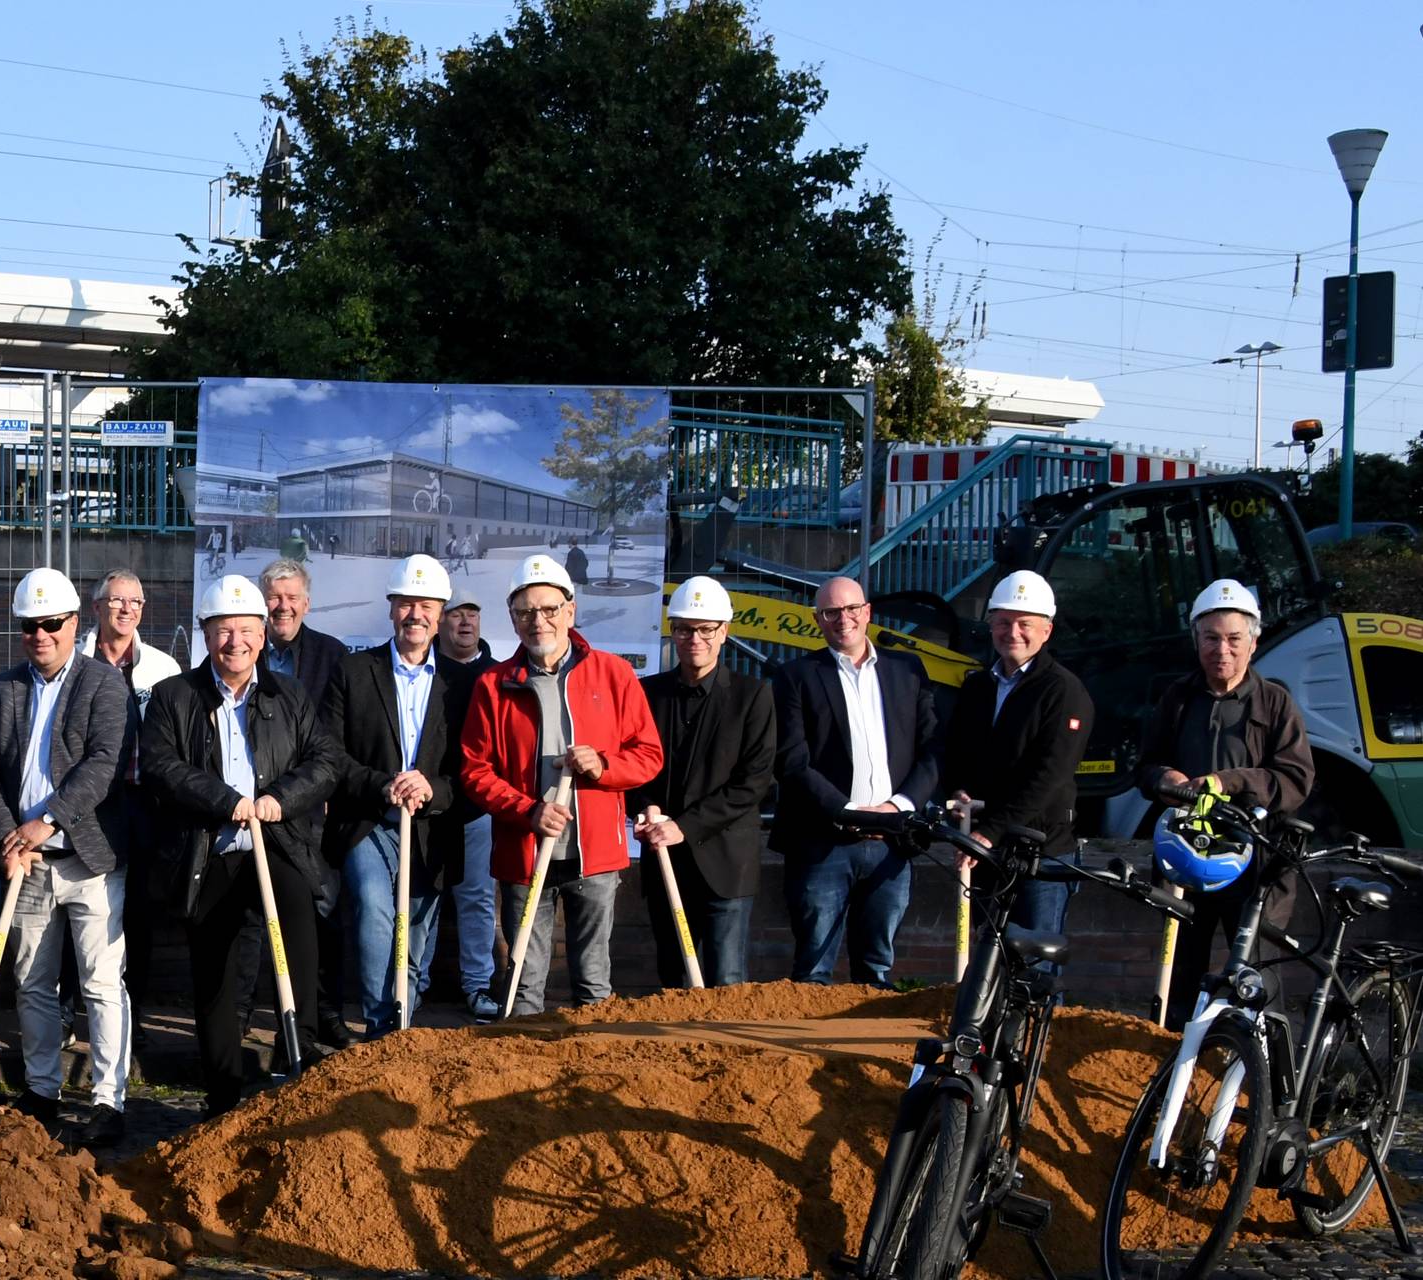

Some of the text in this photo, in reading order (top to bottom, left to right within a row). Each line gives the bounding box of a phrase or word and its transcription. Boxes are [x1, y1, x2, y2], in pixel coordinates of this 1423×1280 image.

[105, 423, 165, 431] BAU-ZAUN
[730, 607, 824, 639] ebr. Reu
[1356, 618, 1423, 640] 508
